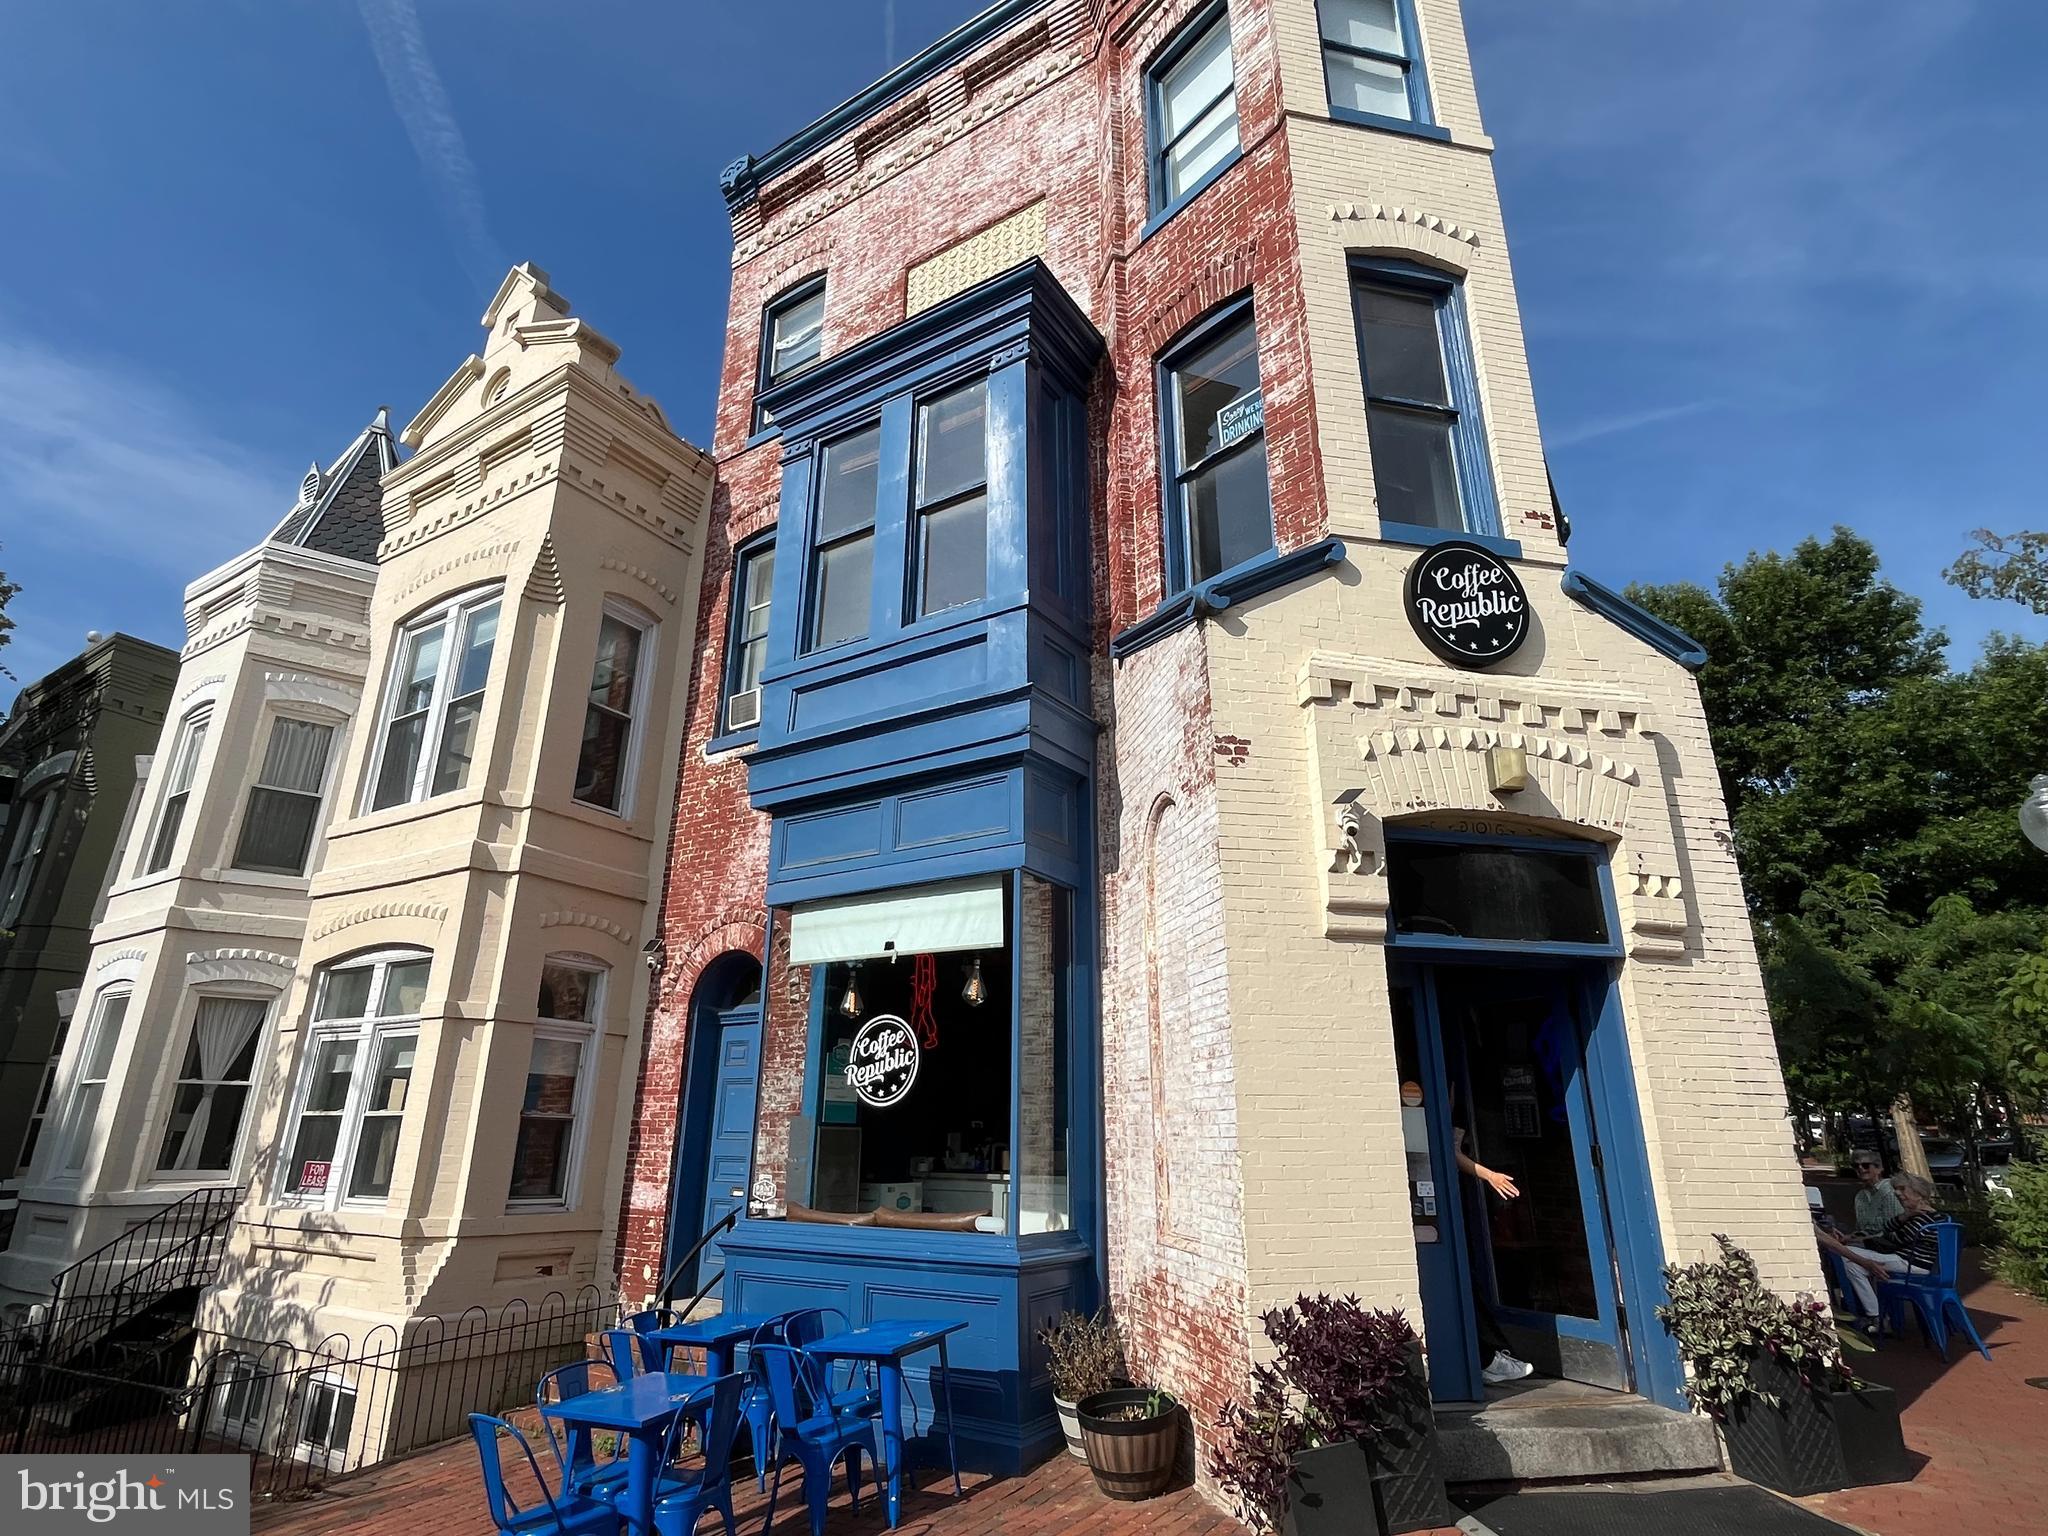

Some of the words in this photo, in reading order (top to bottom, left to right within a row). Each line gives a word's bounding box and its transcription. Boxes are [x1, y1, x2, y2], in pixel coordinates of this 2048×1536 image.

[1222, 403, 1246, 427] Sorry
[1431, 563, 1504, 598] Coffee
[1416, 590, 1523, 628] Republic
[857, 1029, 906, 1060] Coffee
[844, 1048, 915, 1087] Republic
[301, 1175, 327, 1187] LEASE
[309, 1164, 325, 1175] FOR
